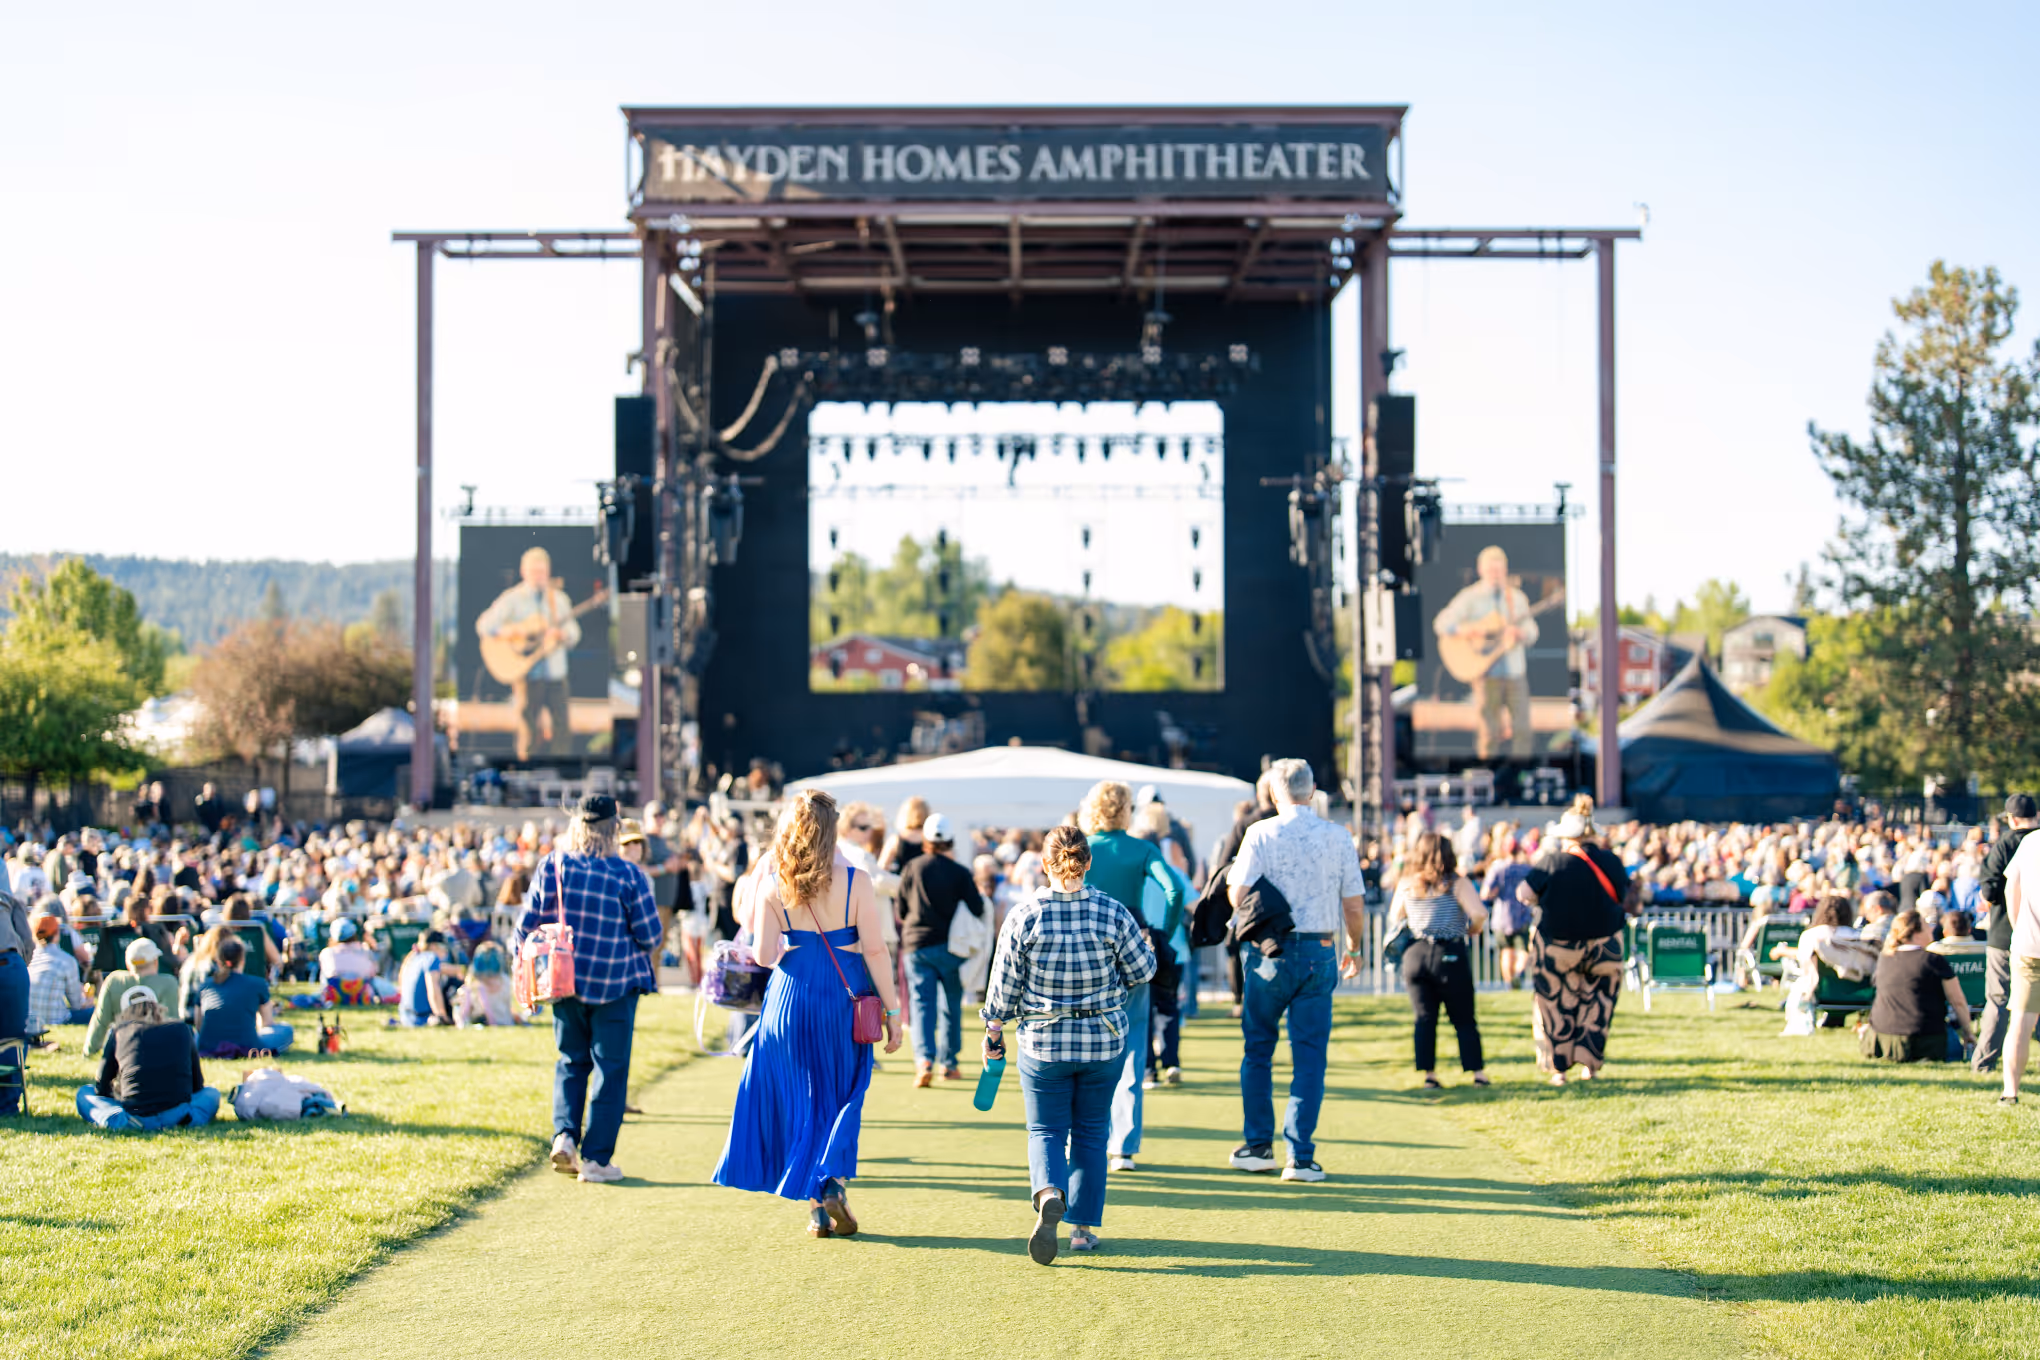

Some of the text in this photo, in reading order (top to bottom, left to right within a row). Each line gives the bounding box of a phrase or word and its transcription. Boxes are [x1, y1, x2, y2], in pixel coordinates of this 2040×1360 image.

[659, 143, 1371, 183] HAYDEN HOMES AMPHITHEATER
